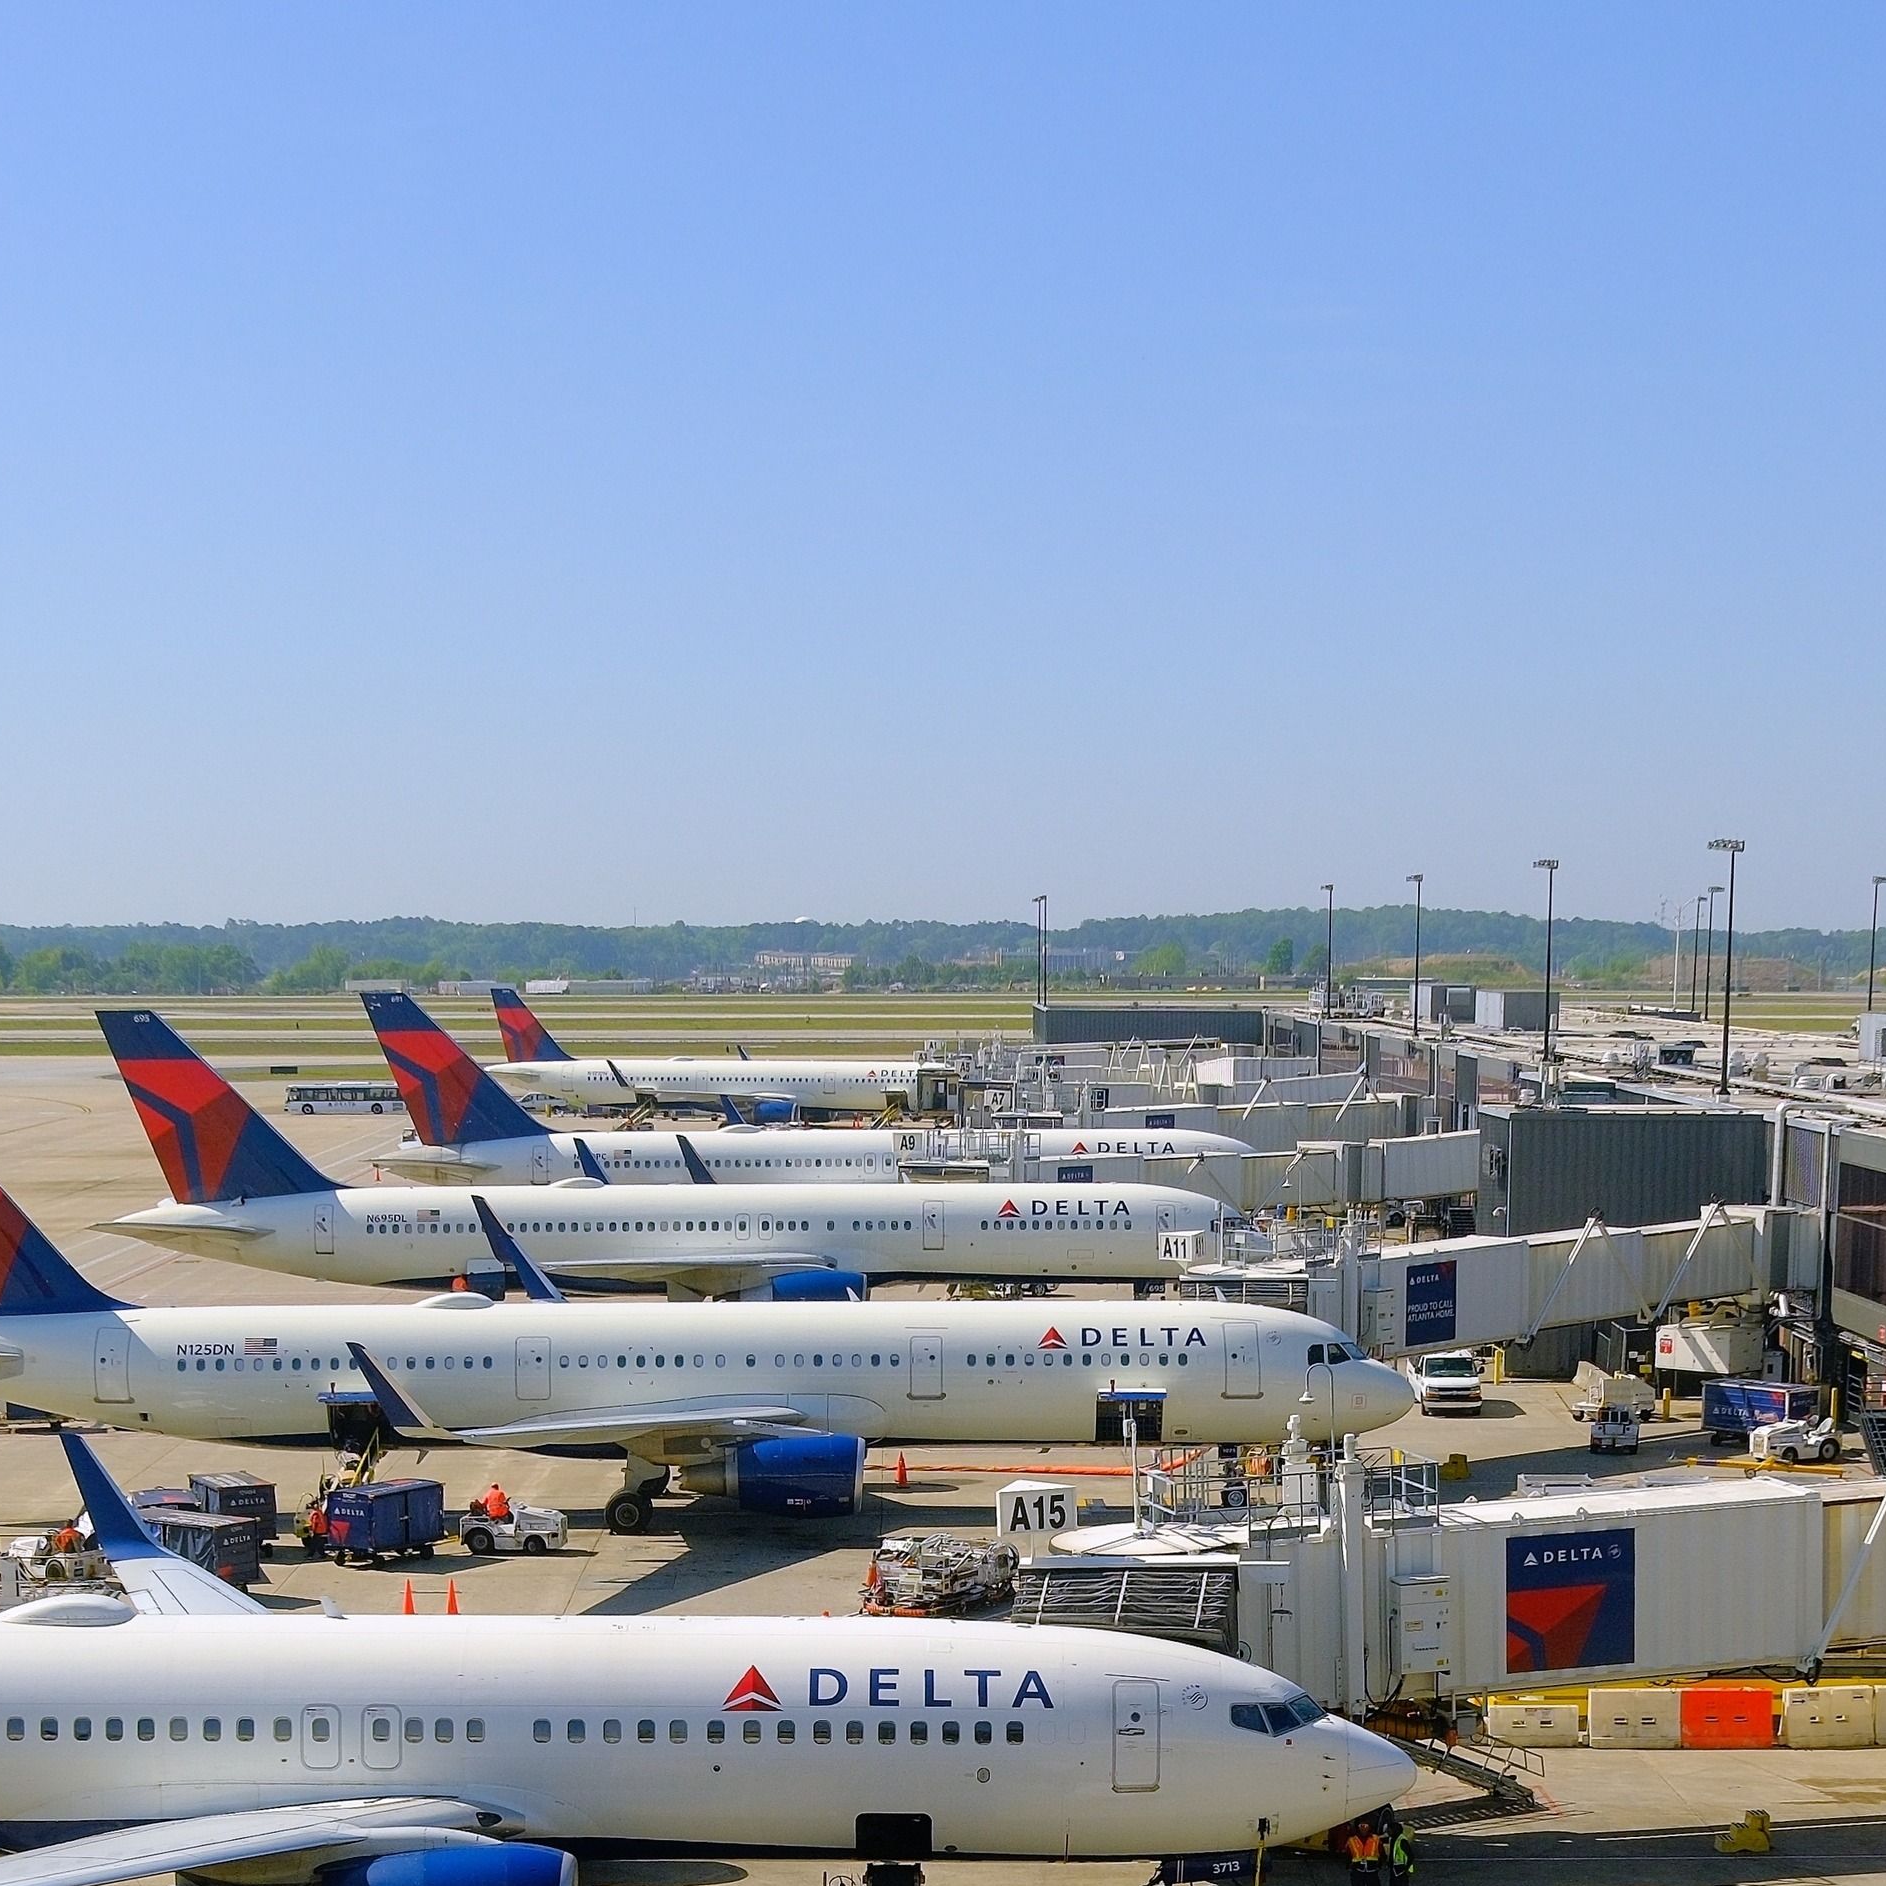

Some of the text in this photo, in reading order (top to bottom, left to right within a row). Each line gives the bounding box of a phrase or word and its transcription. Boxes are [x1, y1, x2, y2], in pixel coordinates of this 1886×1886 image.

[991, 1093, 1004, 1105] A7
[900, 1135, 916, 1151] A9
[1098, 1142, 1175, 1154] DELTA
[1031, 1200, 1130, 1216] DELTA
[366, 1214, 408, 1224] N695DL
[1163, 1237, 1187, 1259] A11
[1416, 1274, 1440, 1285] DELTA
[1149, 1285, 1165, 1293] 695
[1408, 1301, 1454, 1314] PROUD TO CALL
[1408, 1311, 1435, 1323] ATLANTA
[1080, 1328, 1207, 1347] DELTA
[175, 1343, 236, 1356] N125DN
[238, 1496, 267, 1507] DELTA
[341, 1508, 365, 1517] DELTA
[1010, 1494, 1067, 1532] A15
[229, 1535, 251, 1545] DELTA
[1544, 1549, 1603, 1564] DELTA
[809, 1667, 1055, 1709] DELTA
[1212, 1860, 1241, 1874] 3713
